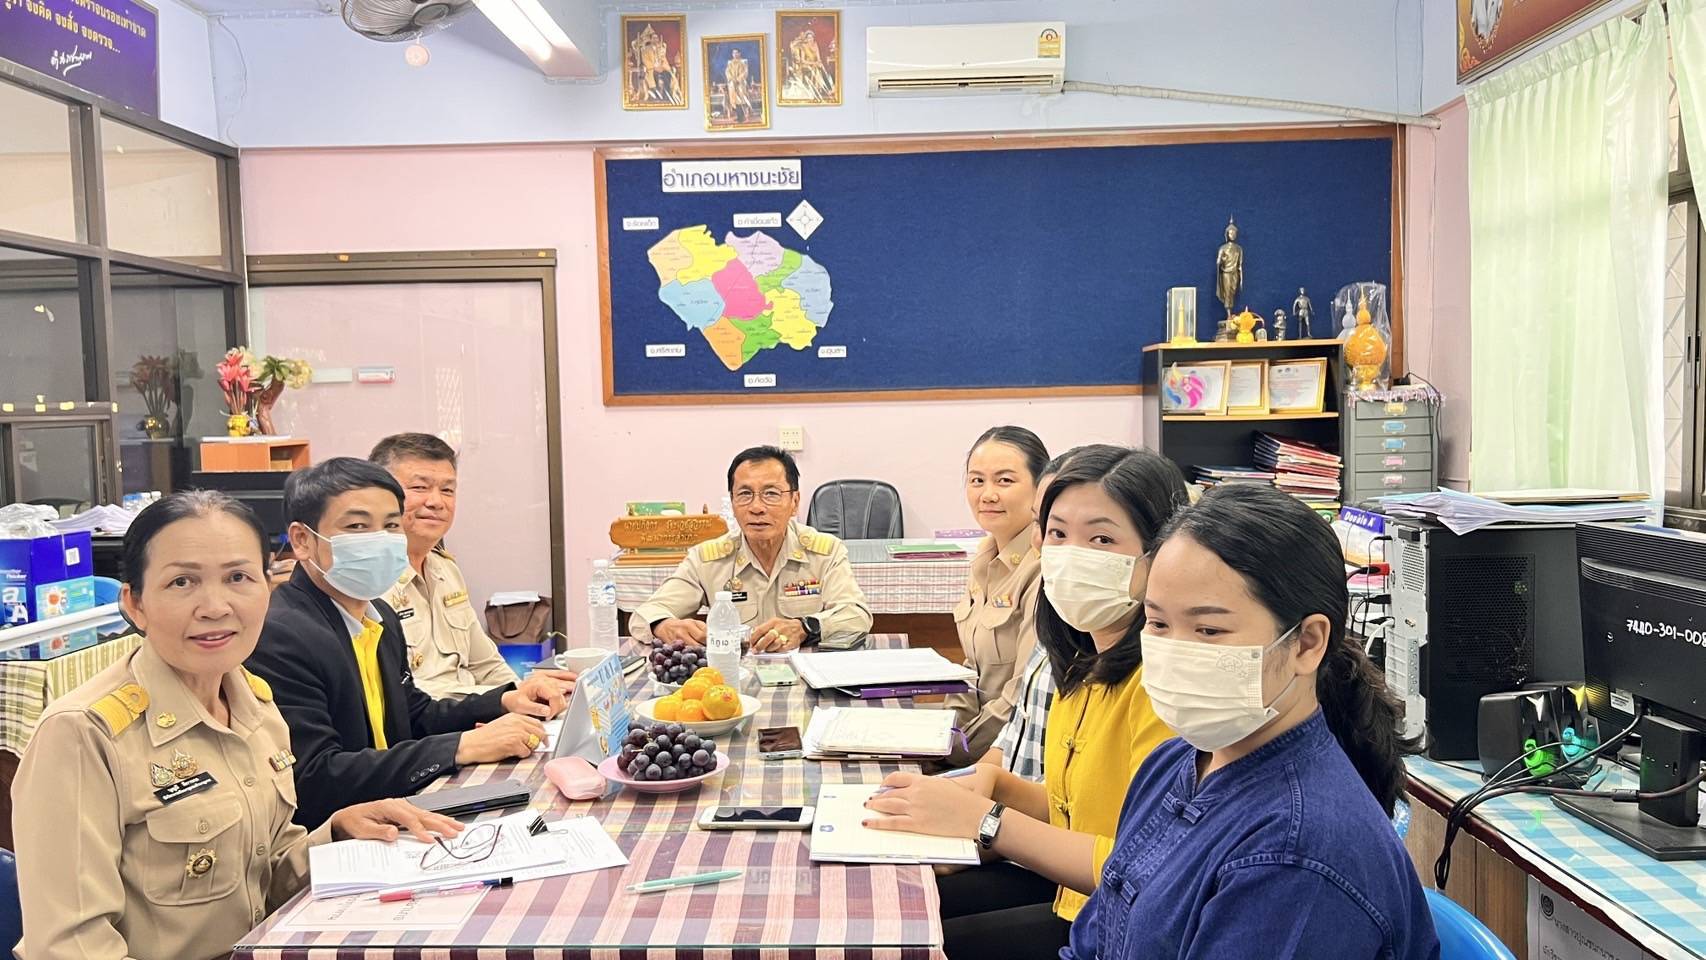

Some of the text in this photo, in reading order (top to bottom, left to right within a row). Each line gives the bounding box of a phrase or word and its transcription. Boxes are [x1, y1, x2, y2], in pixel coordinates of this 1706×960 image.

[663, 166, 800, 188] อำเภอมหาชนะชัย
